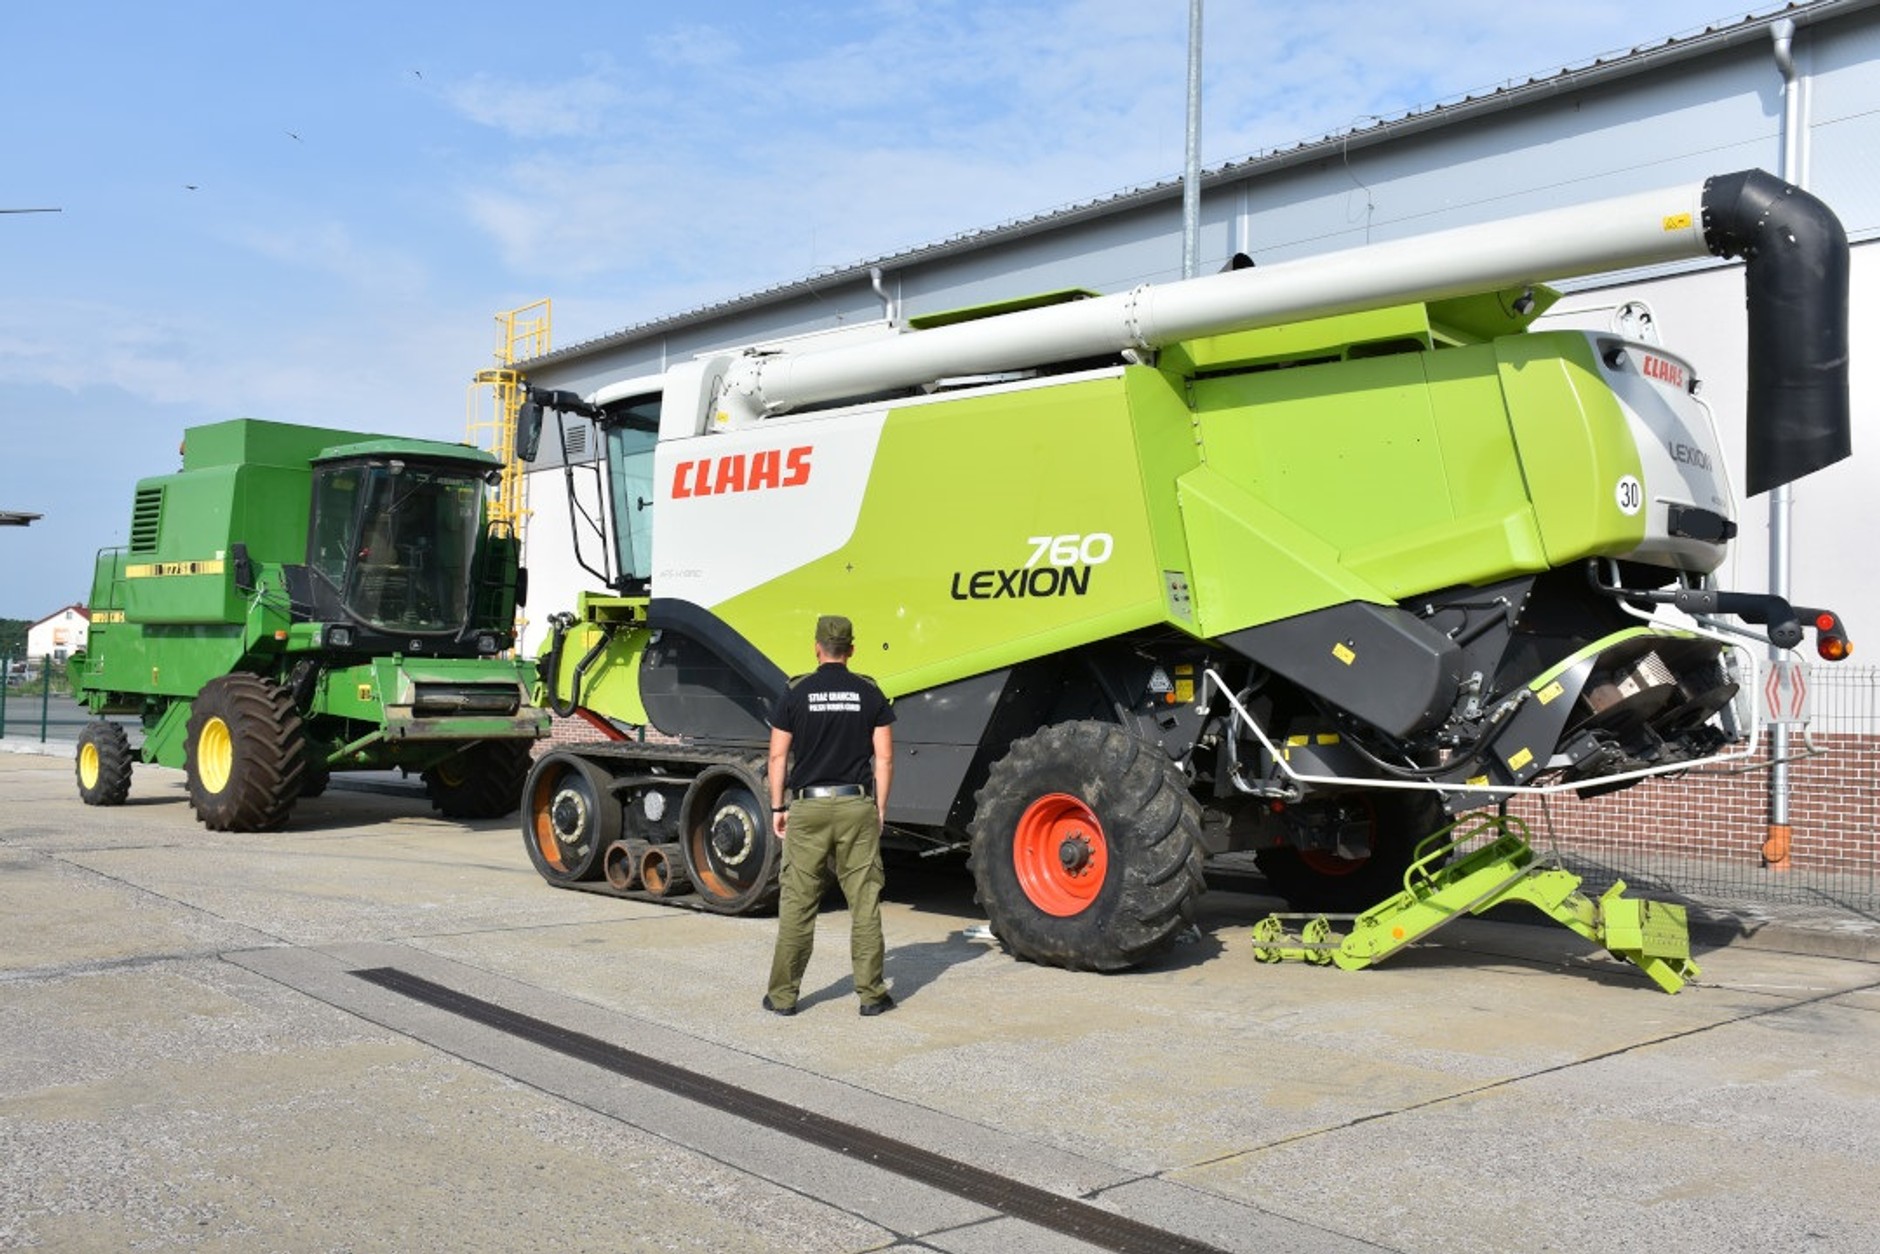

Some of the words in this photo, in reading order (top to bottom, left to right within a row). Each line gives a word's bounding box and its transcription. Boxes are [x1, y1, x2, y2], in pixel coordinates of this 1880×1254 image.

[1643, 354, 1683, 387] CLAAS
[671, 445, 814, 499] CLAAS
[1669, 441, 1713, 472] LEXION
[1620, 482, 1639, 508] 30
[1024, 532, 1114, 569] 760
[950, 565, 1092, 600] LEXION
